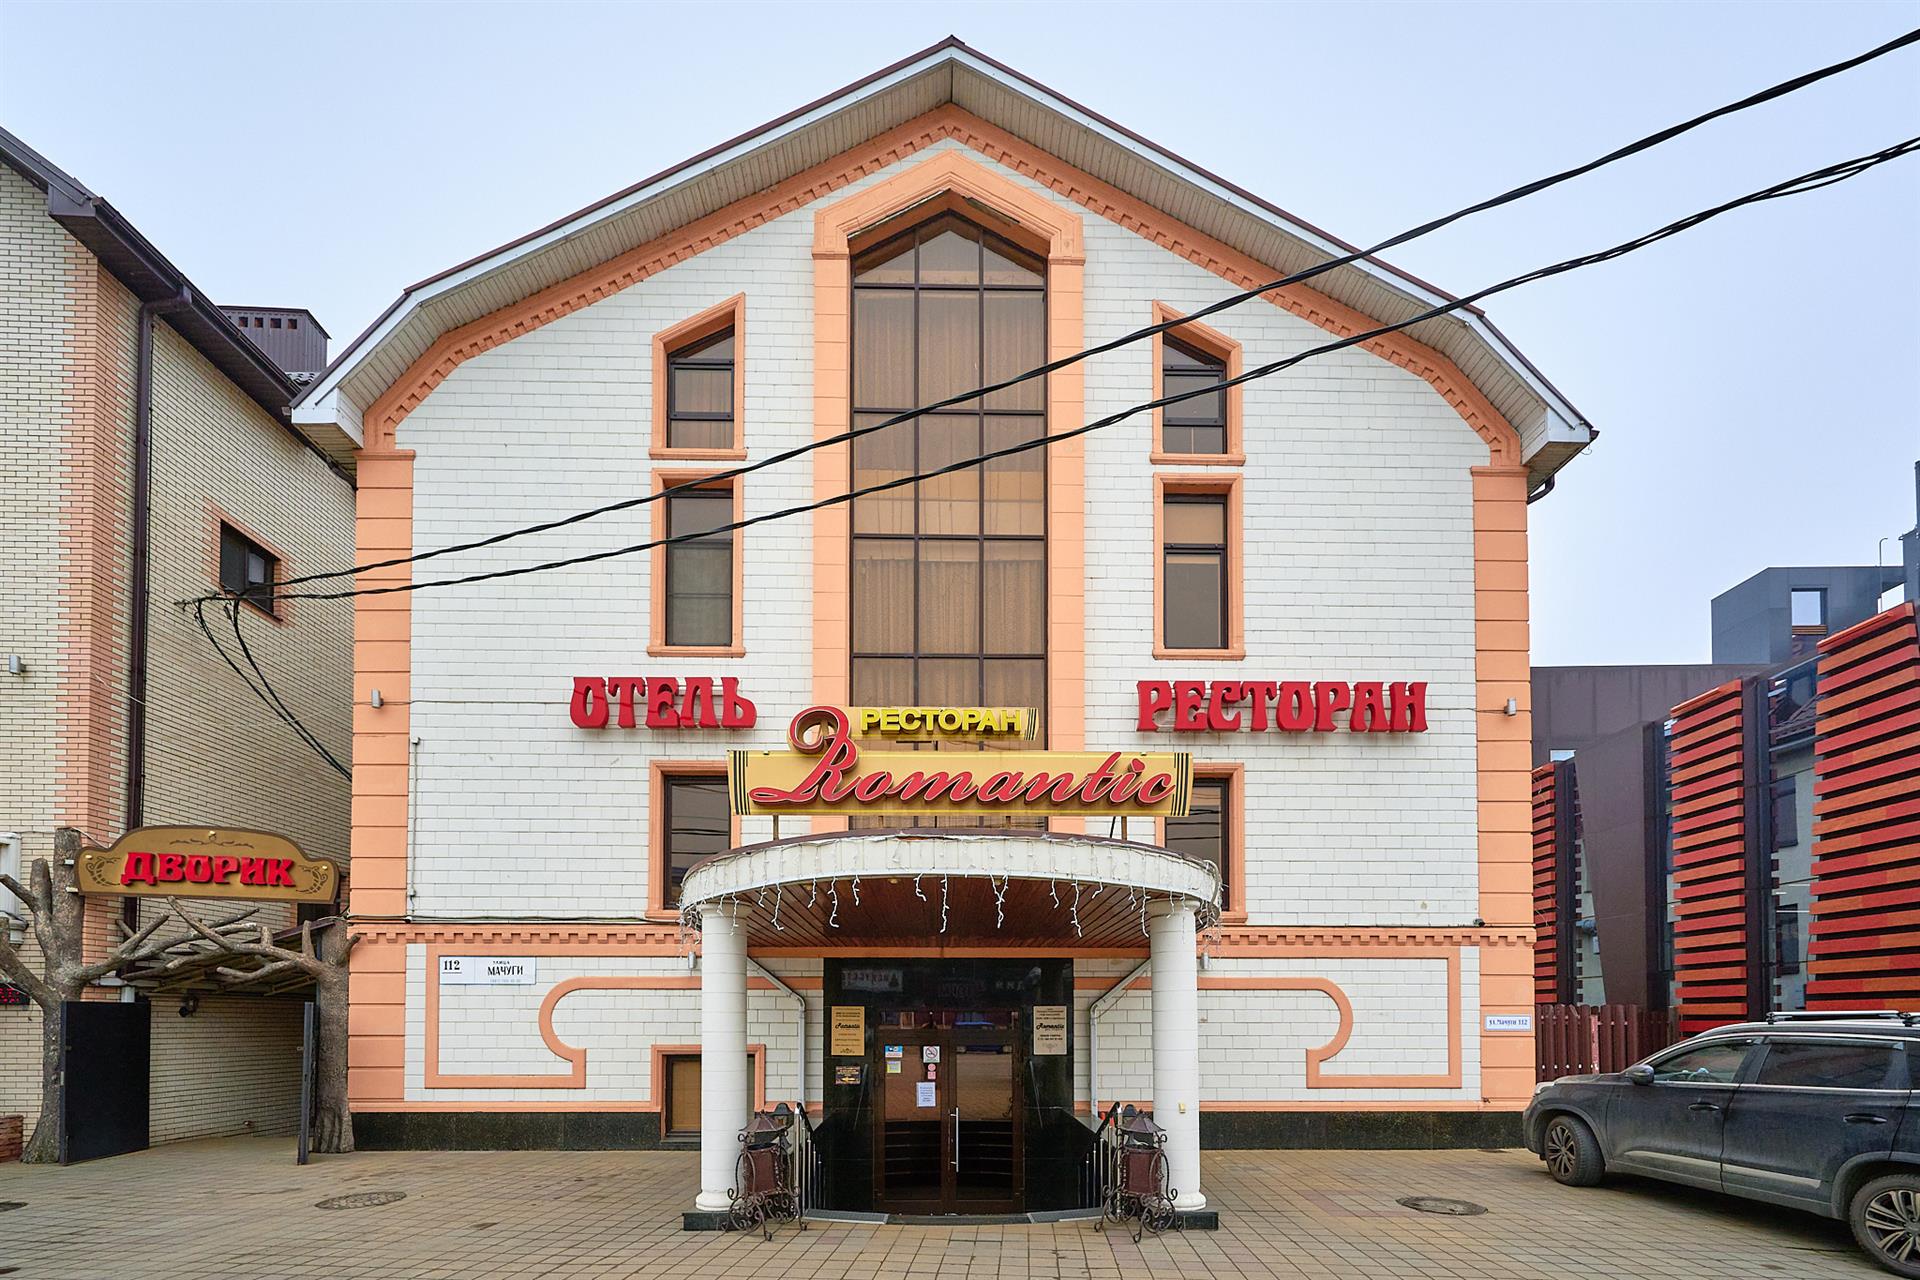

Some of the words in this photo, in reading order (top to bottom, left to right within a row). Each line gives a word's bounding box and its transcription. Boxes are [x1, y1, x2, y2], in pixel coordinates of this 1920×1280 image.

[570, 677, 758, 729] ОТЕЛЬ
[860, 707, 1022, 734] РЕСТОРАН
[1136, 680, 1429, 733] РЕСТОРАН
[748, 705, 1177, 805] Romantic
[120, 852, 297, 888] ДВОРИК
[443, 960, 461, 971] 112
[487, 965, 524, 976] МАЧУГИ
